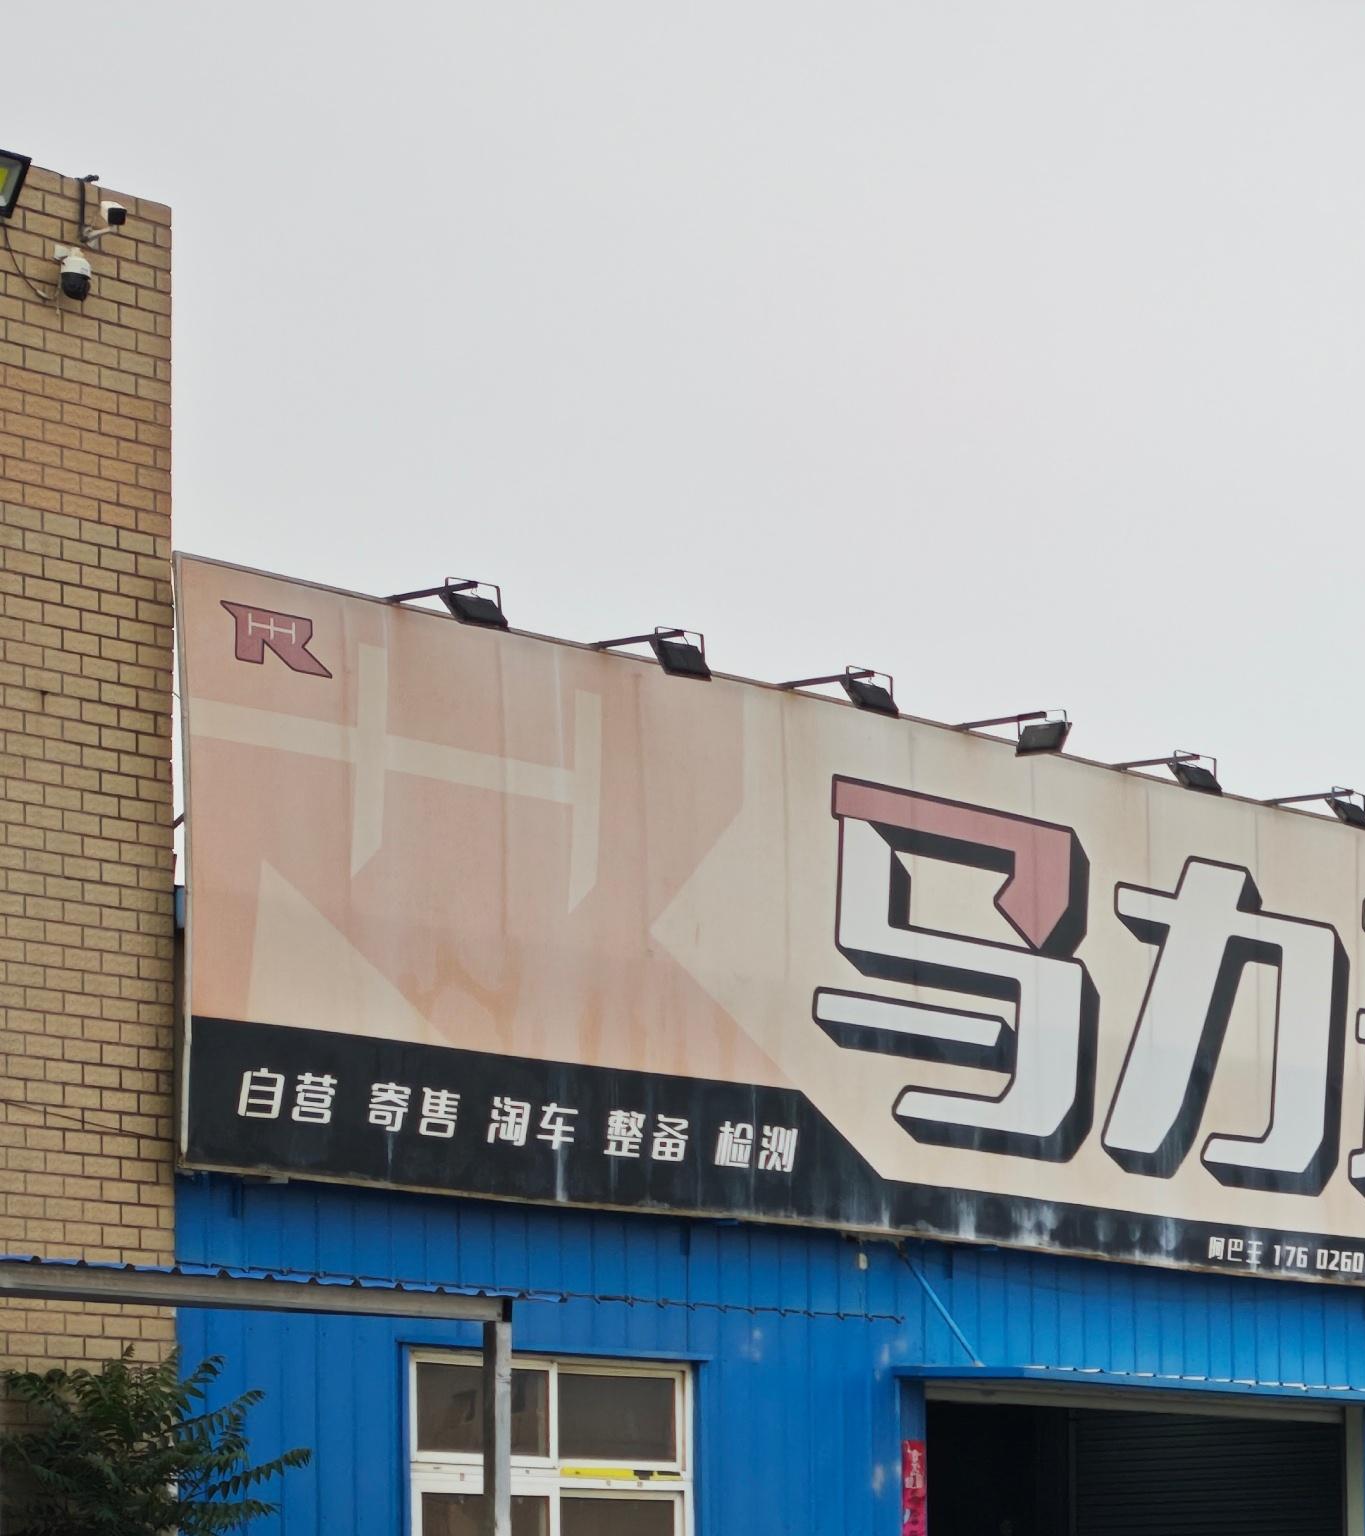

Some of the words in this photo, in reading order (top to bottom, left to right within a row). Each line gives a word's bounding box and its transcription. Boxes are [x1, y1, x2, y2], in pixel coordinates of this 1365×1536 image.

[237, 1067, 338, 1124] 自营
[368, 1082, 461, 1138] 寄售
[487, 1096, 579, 1150] 淘车
[603, 1109, 689, 1162] 整备
[714, 1120, 798, 1172] 检测
[1208, 1236, 1263, 1265] 阿巴王
[1273, 1244, 1308, 1268] 176
[1316, 1249, 1364, 1273] 0260
